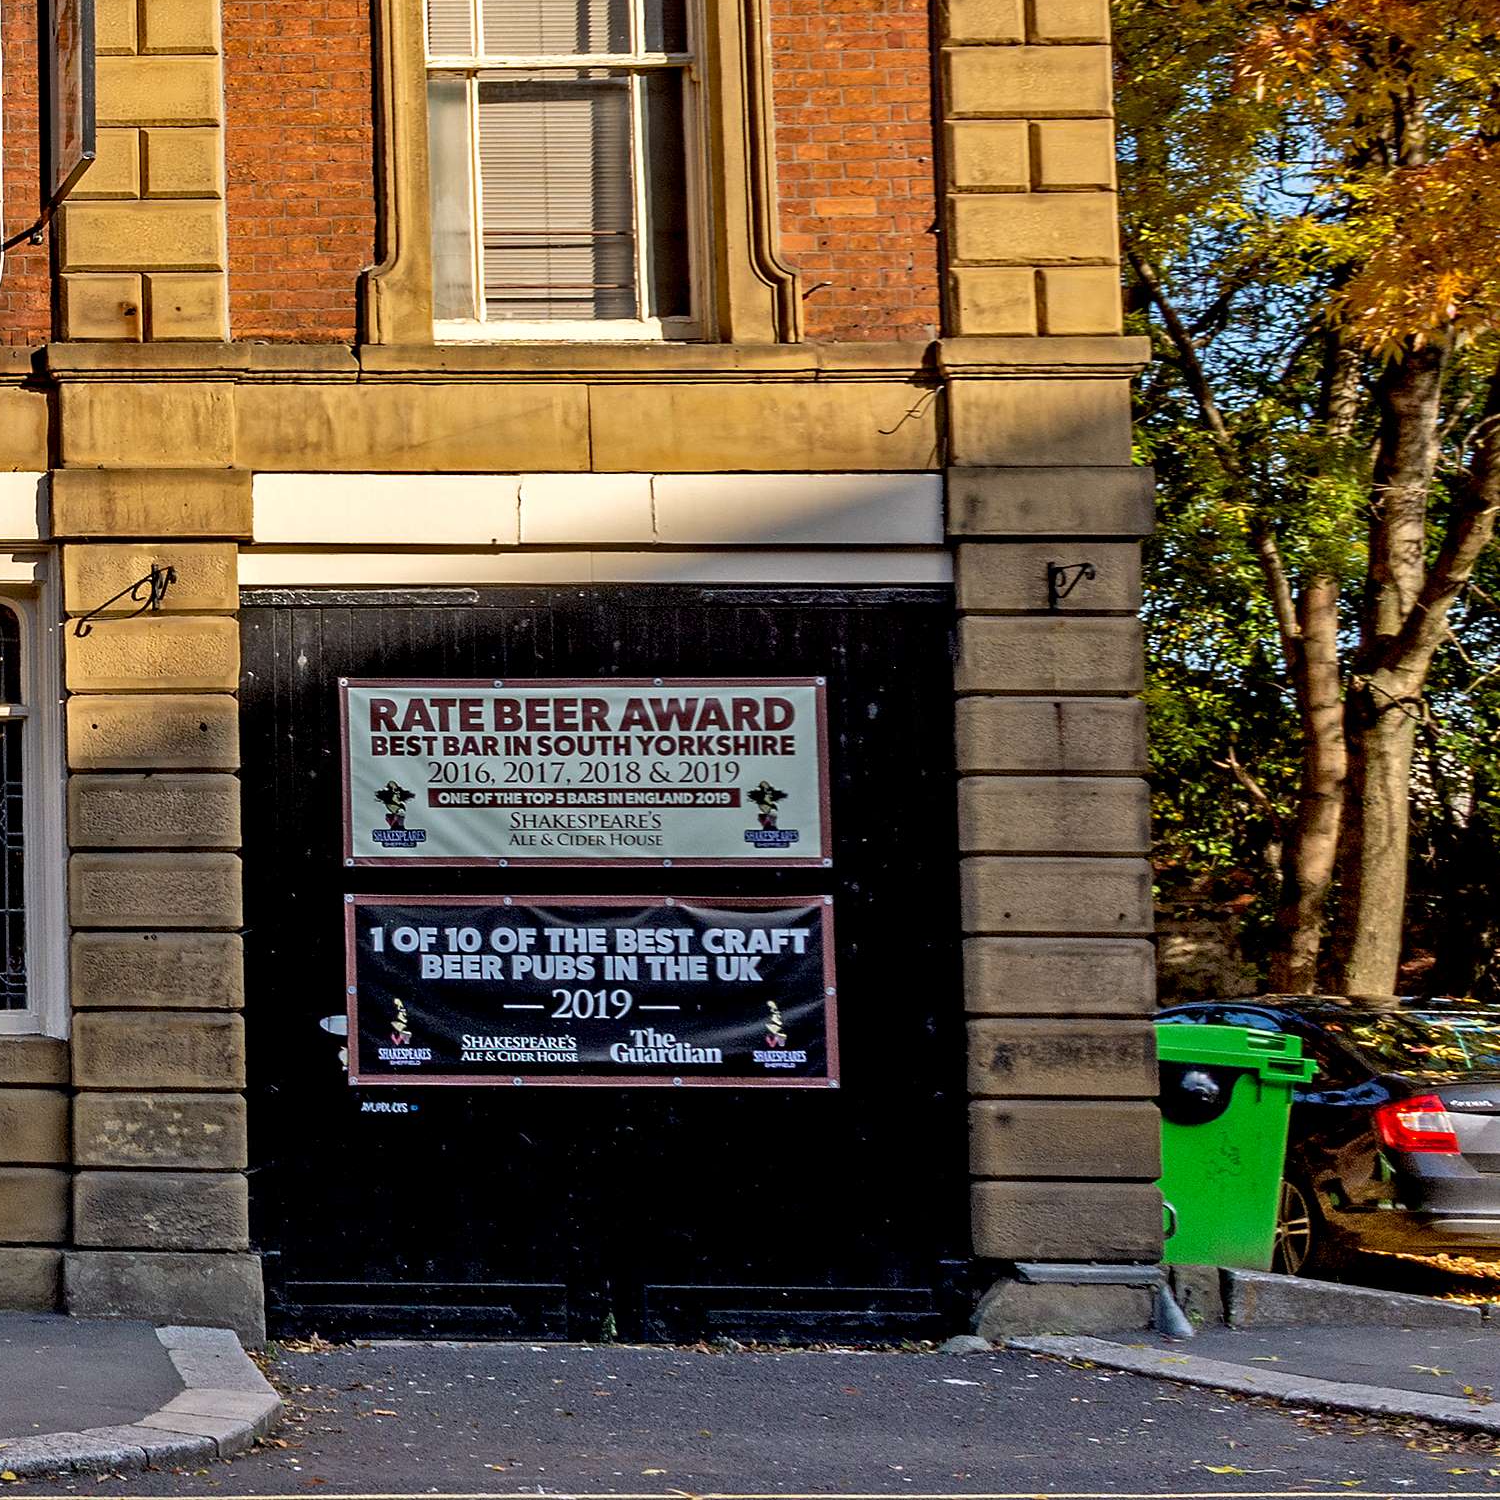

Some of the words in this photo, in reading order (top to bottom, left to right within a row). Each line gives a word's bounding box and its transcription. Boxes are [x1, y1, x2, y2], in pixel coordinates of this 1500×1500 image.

[369, 698, 485, 732] RATE
[494, 698, 612, 732] BEER
[618, 697, 795, 731] AWARD
[371, 736, 438, 756] BEST
[443, 736, 499, 756] BAR
[504, 736, 532, 756] IN
[536, 736, 631, 756] SOUTH
[636, 735, 795, 756] YORKSHIRE
[427, 761, 496, 784] 2016,
[503, 761, 572, 784] 2017,
[579, 761, 641, 783] 2018
[649, 761, 673, 783] &
[678, 761, 740, 783] 2019
[438, 793, 470, 805] ONE
[472, 793, 493, 805] OF
[493, 793, 521, 805] THE
[525, 793, 556, 805] TOP
[558, 793, 566, 805] 5
[567, 793, 605, 805] BARS
[608, 793, 623, 805] IN
[627, 793, 693, 804] ENGLAND
[695, 793, 731, 804] 2019
[509, 811, 662, 829] SHAKESPEARE'S
[541, 833, 554, 845] &
[610, 833, 663, 846] HOUSE
[370, 927, 384, 951] 1
[392, 927, 437, 952] OF
[445, 927, 482, 952] 10
[491, 927, 537, 952] OF
[544, 928, 607, 953] THE
[616, 928, 694, 953] BEST
[702, 928, 809, 953] CRAFT
[421, 955, 504, 979] BEER
[512, 955, 595, 980] PUBS
[604, 956, 638, 980] IN
[645, 956, 708, 981] THE
[717, 956, 763, 981] UK
[551, 989, 633, 1019] 2019
[462, 1034, 577, 1049] SHAKESPEARE'S
[630, 1028, 676, 1048] The
[485, 1051, 496, 1061] &
[538, 1051, 578, 1062] HOUSE
[610, 1042, 723, 1063] Guardian
